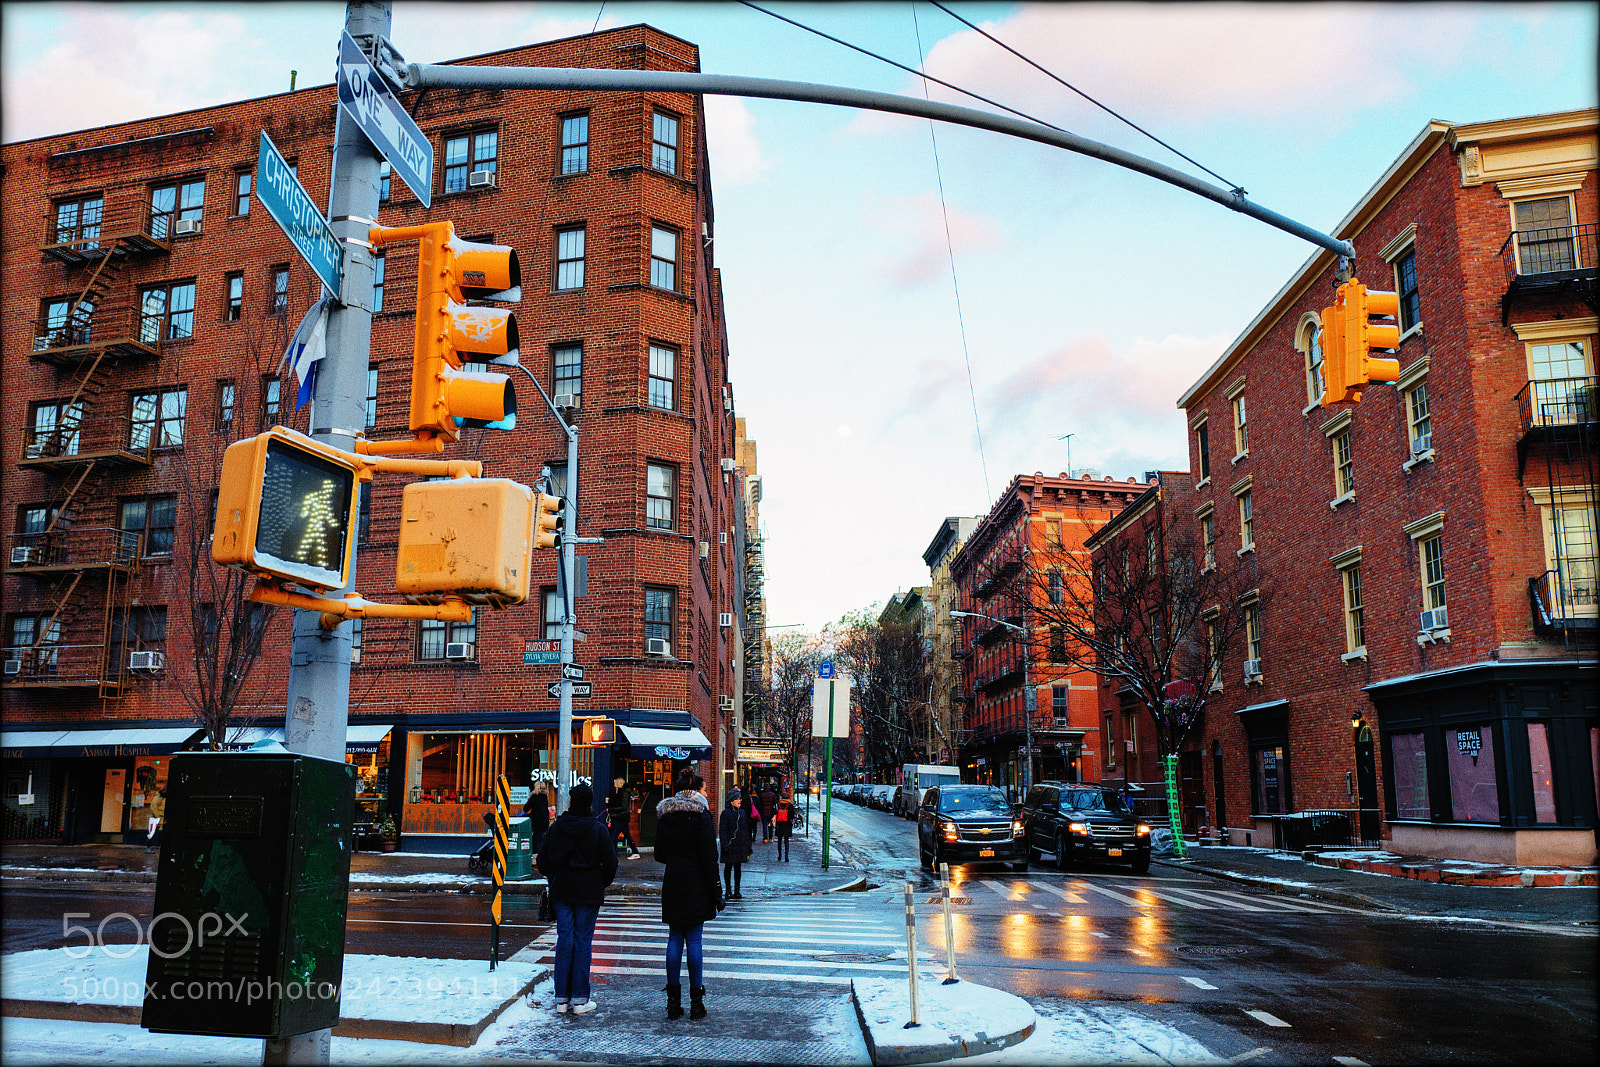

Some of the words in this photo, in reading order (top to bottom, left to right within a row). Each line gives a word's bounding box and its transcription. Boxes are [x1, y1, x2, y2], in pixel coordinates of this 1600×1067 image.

[352, 69, 382, 127] ONE
[398, 125, 425, 175] WAY
[265, 149, 340, 274] CHRISTOPHER
[291, 221, 315, 260] STREET
[525, 641, 550, 651] HUDSON
[552, 641, 561, 651] ST
[574, 686, 588, 694] WAY
[1457, 731, 1480, 741] RETAIL
[1458, 740, 1481, 750] SPACE
